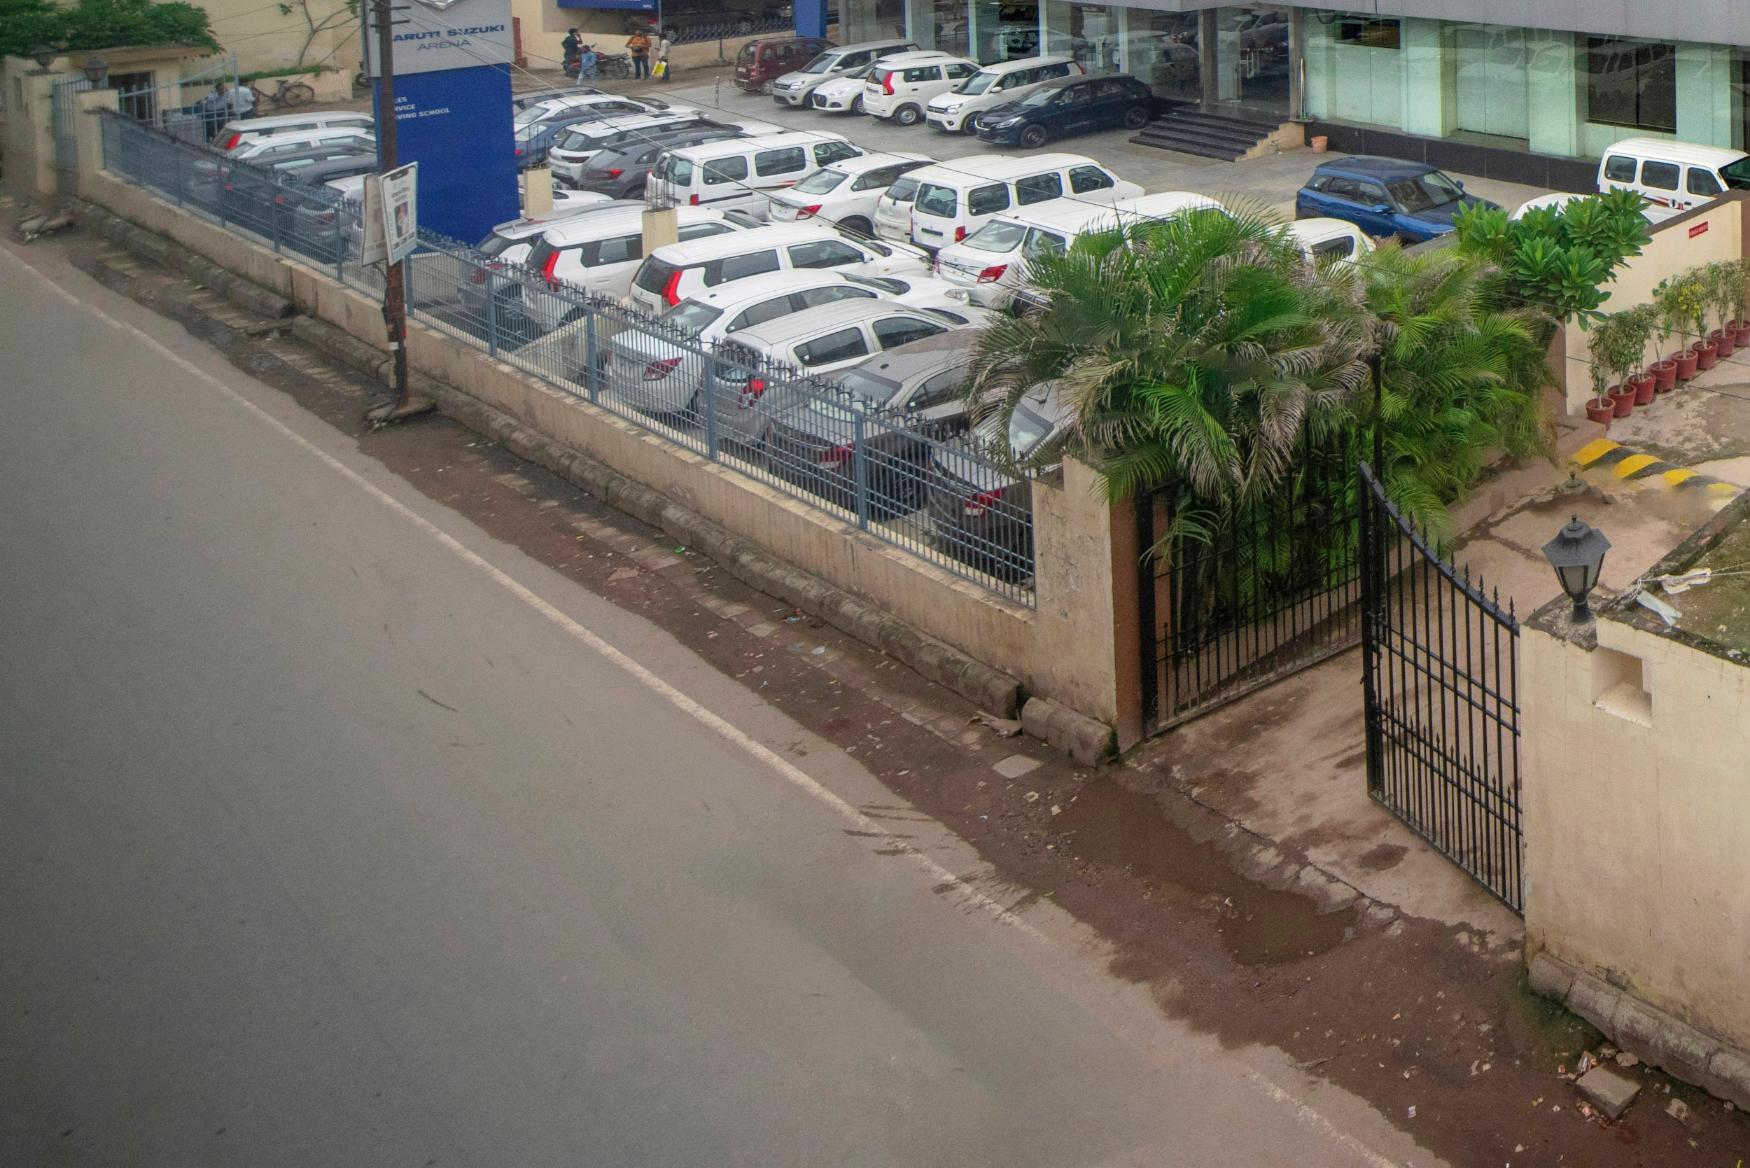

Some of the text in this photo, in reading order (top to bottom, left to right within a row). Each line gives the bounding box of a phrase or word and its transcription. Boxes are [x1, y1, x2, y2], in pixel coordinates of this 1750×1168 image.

[393, 24, 505, 42] ARUTI SUZUKI
[416, 39, 472, 51] ARENA
[418, 107, 449, 117] SCHOOL
